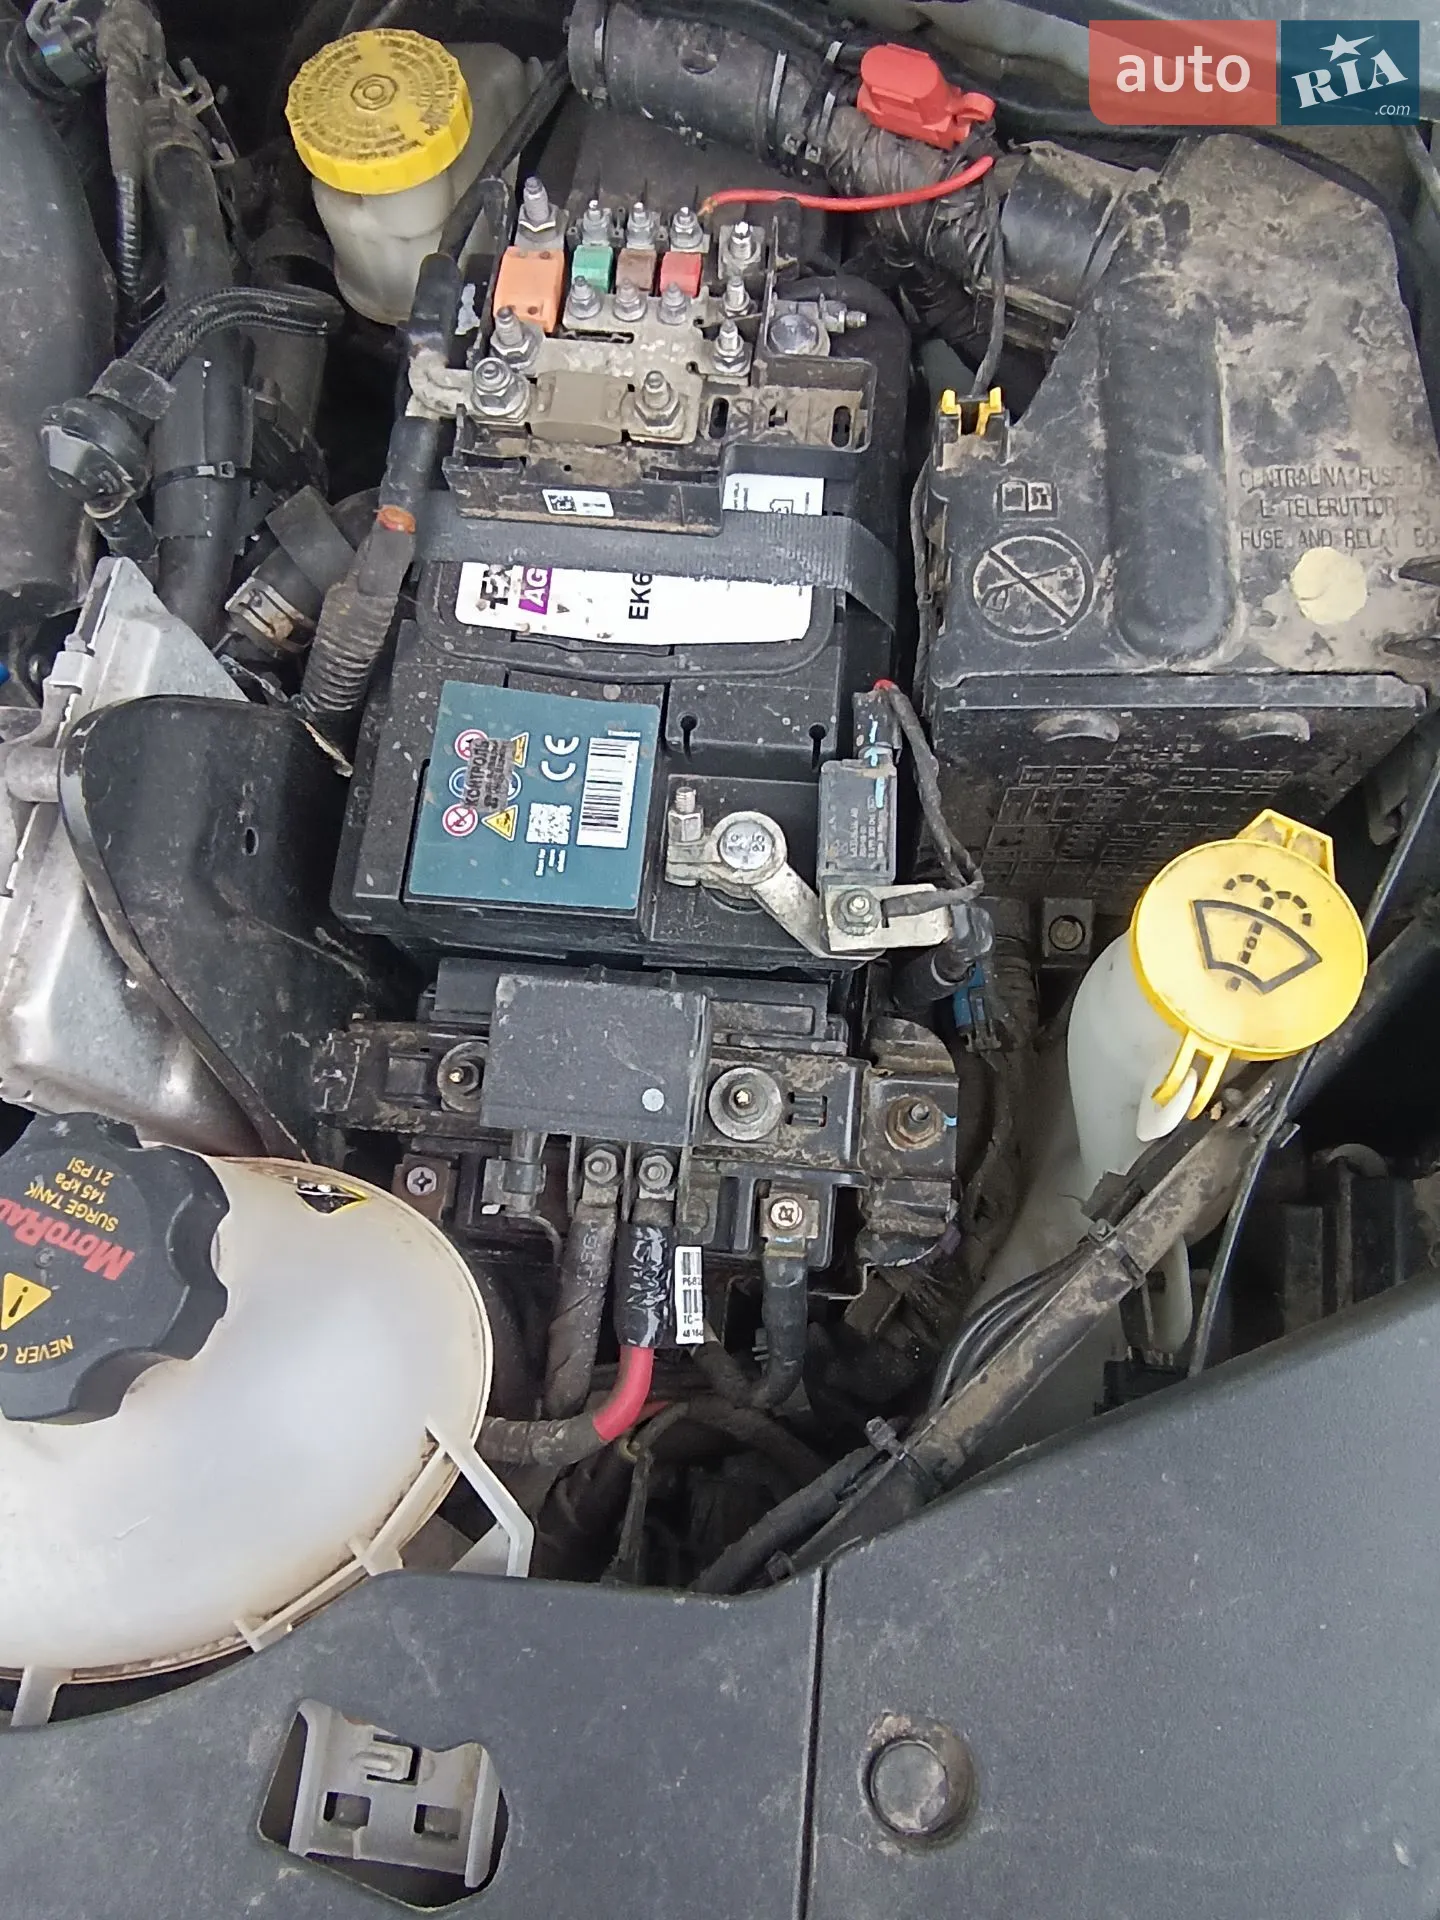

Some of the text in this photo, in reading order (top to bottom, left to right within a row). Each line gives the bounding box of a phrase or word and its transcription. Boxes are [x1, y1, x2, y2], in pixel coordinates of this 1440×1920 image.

[1240, 529, 1285, 549] FUSE
[1298, 528, 1333, 549] AND
[464, 738, 490, 809] КОНТРОЛЬ
[67, 1156, 114, 1186] 21 PSI
[55, 1172, 107, 1205] 145 kPa
[24, 1181, 119, 1232] SURGE TANK
[15, 1335, 75, 1365] NEVER
